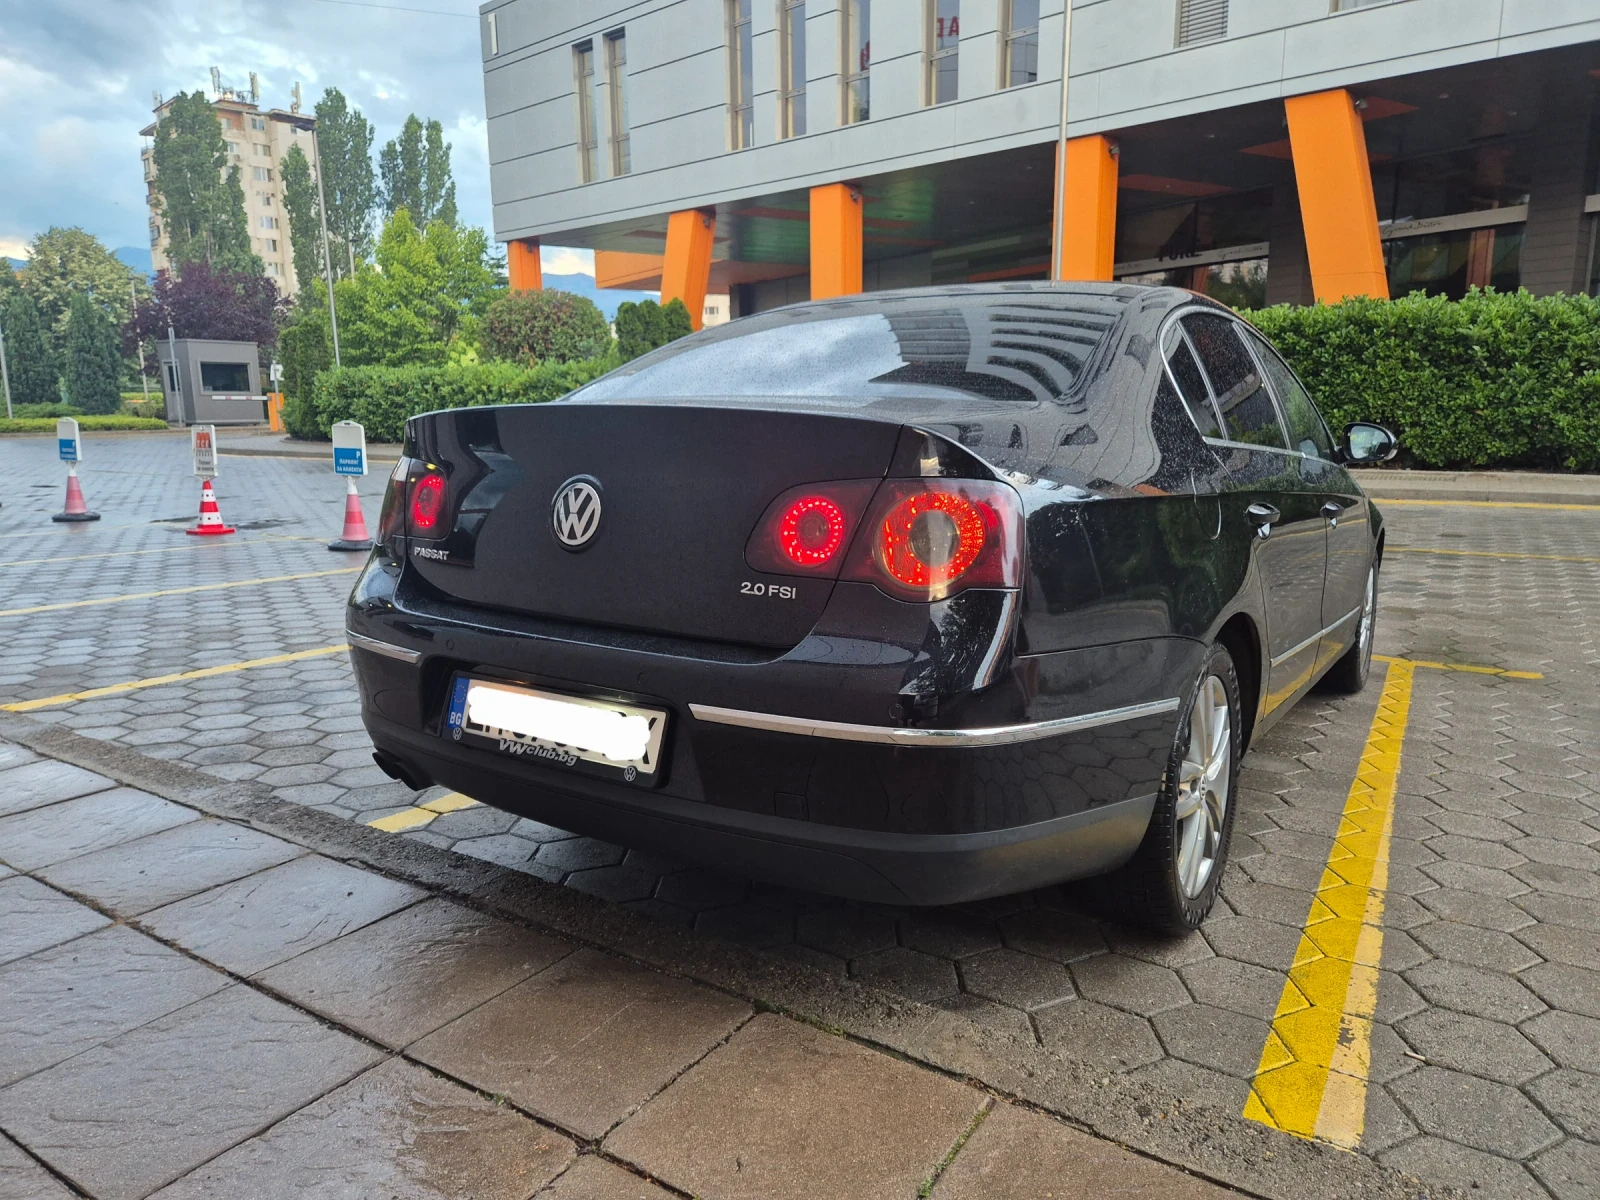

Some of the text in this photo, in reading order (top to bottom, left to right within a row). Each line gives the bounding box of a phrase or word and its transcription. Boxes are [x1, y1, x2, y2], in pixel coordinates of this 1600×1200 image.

[414, 546, 450, 561] PASSAT
[768, 584, 797, 600] FSI
[449, 711, 462, 725] BG
[499, 738, 578, 767] VWclub.bg
